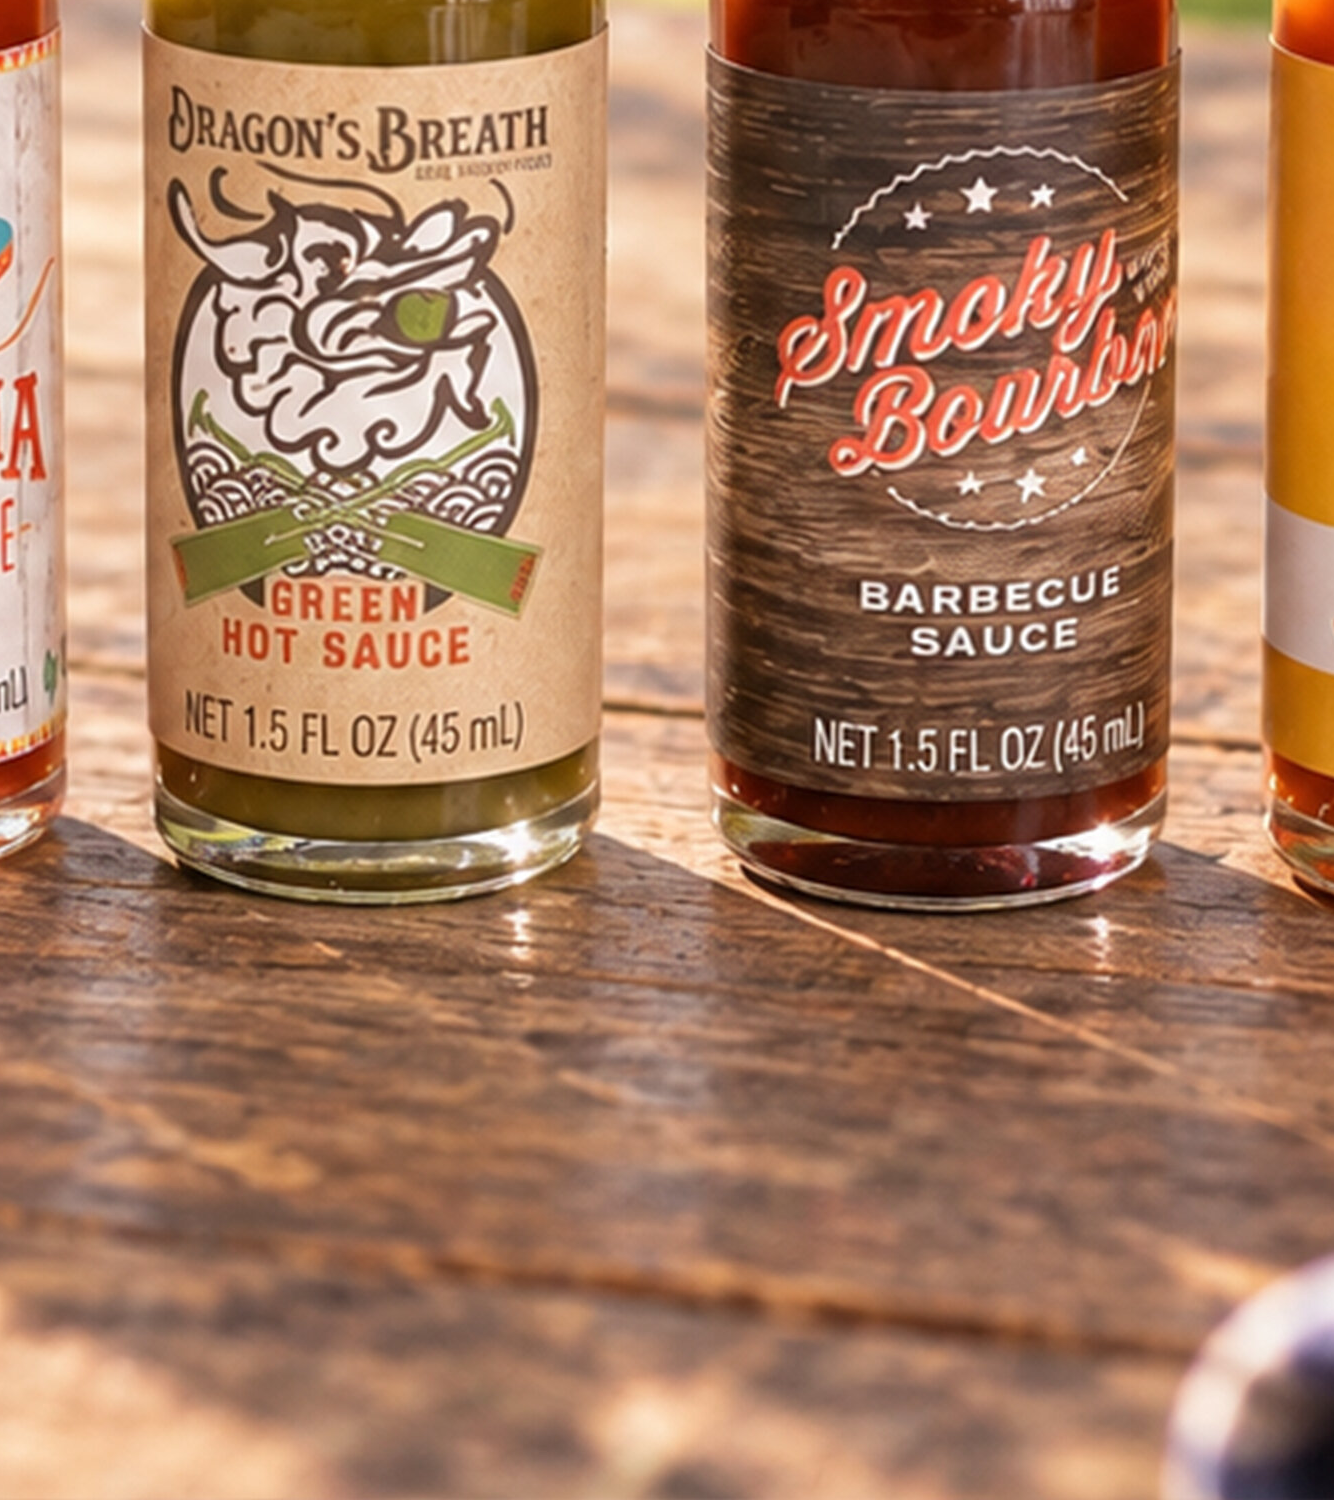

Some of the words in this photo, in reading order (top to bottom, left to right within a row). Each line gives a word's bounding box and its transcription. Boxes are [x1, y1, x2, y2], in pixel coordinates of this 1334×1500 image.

[366, 105, 549, 174] BREATH
[774, 228, 1124, 409] Smoky
[270, 579, 419, 624] GREEN
[859, 565, 1122, 615] BARBECUE
[222, 617, 299, 665] HOT
[322, 625, 472, 670] SAUCE
[909, 617, 1080, 658] SAUCE
[184, 689, 235, 743] NET
[243, 705, 289, 753] 1.5
[300, 713, 341, 757] FL
[350, 713, 399, 758] OZ
[408, 711, 462, 764] (45
[814, 716, 879, 769] NET
[887, 727, 939, 773] 1.5
[948, 727, 992, 773] FL
[1000, 723, 1046, 771] OZ
[1053, 714, 1098, 774] (45
